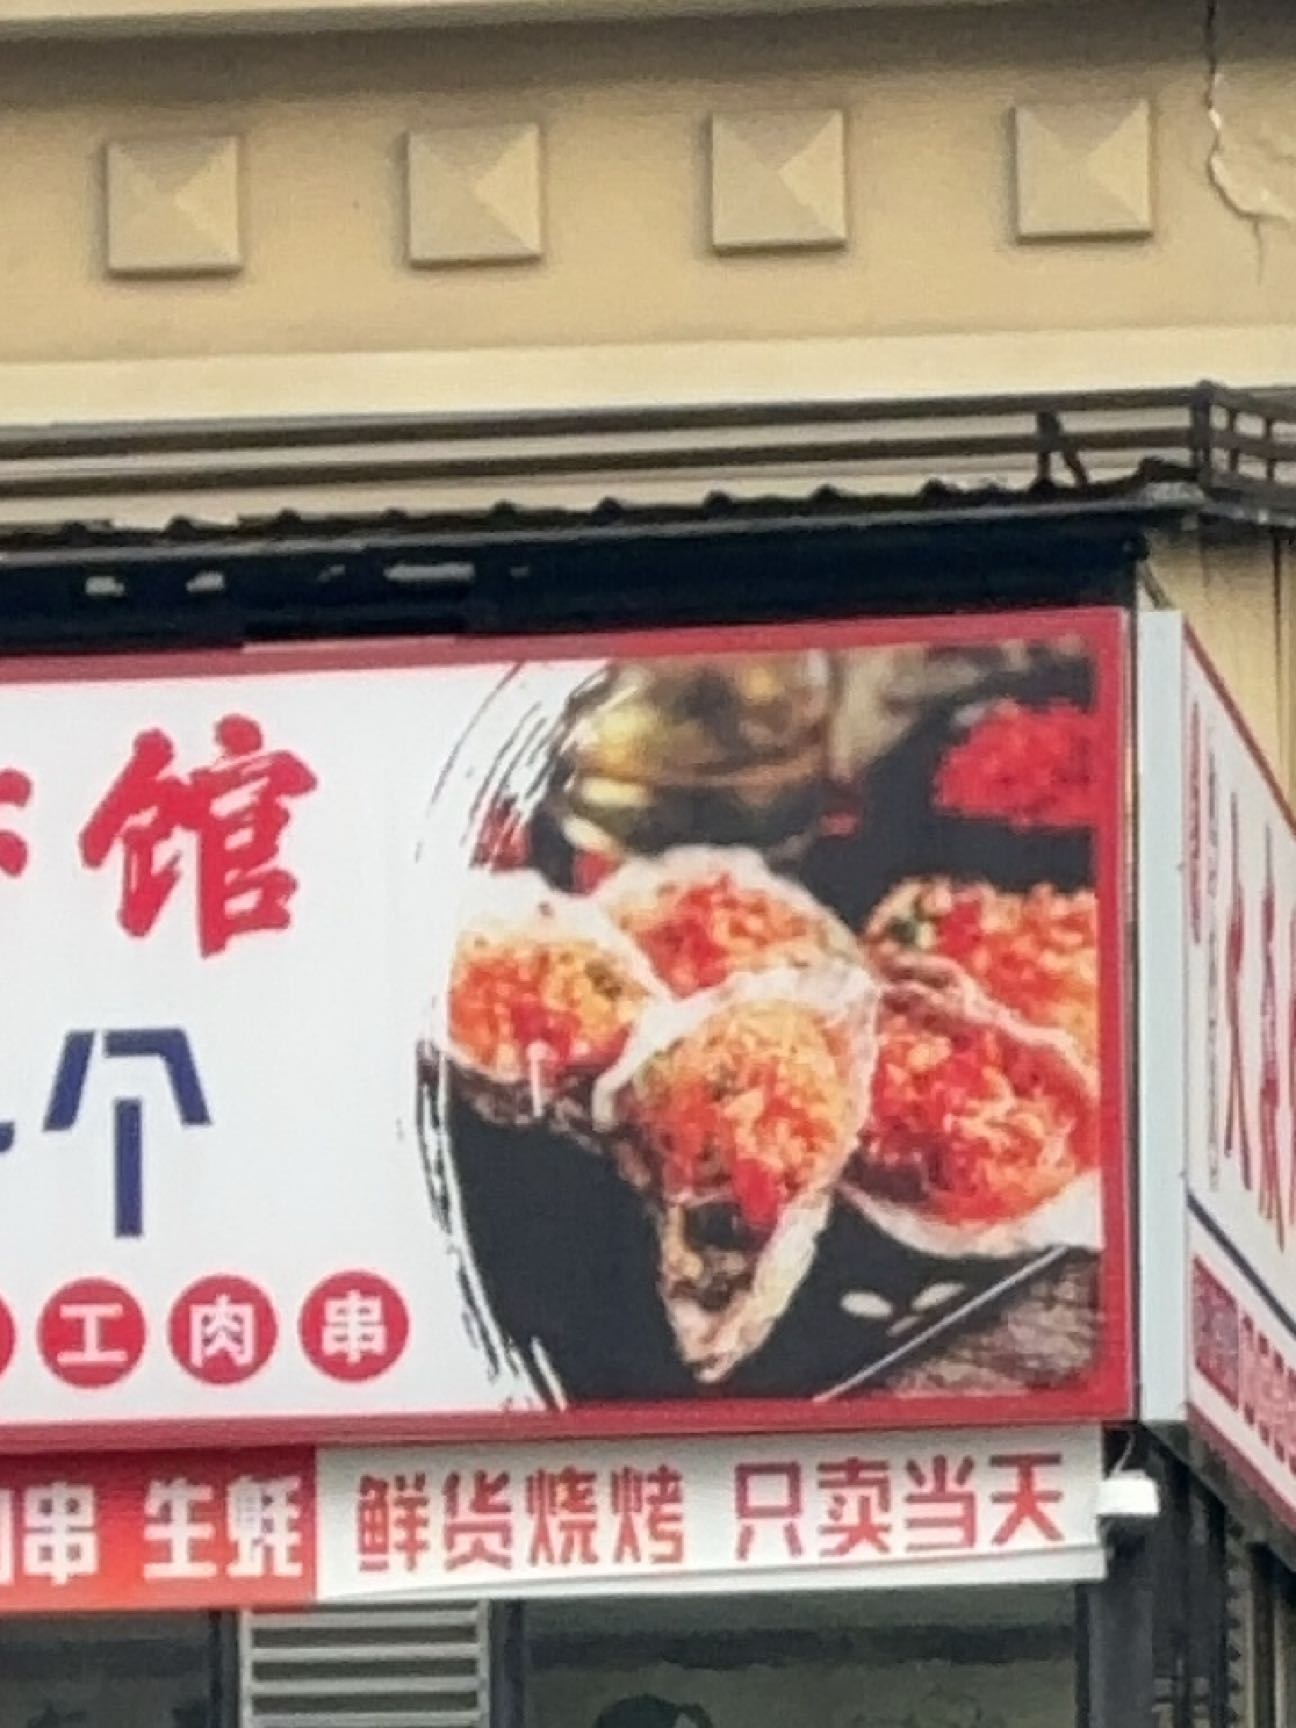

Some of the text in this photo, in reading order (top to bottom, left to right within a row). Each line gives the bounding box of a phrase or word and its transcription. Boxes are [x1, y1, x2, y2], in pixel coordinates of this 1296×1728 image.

[143, 1476, 303, 1579] 生蚝
[357, 1453, 1063, 1572] 鲜货烧烤 只卖当天
